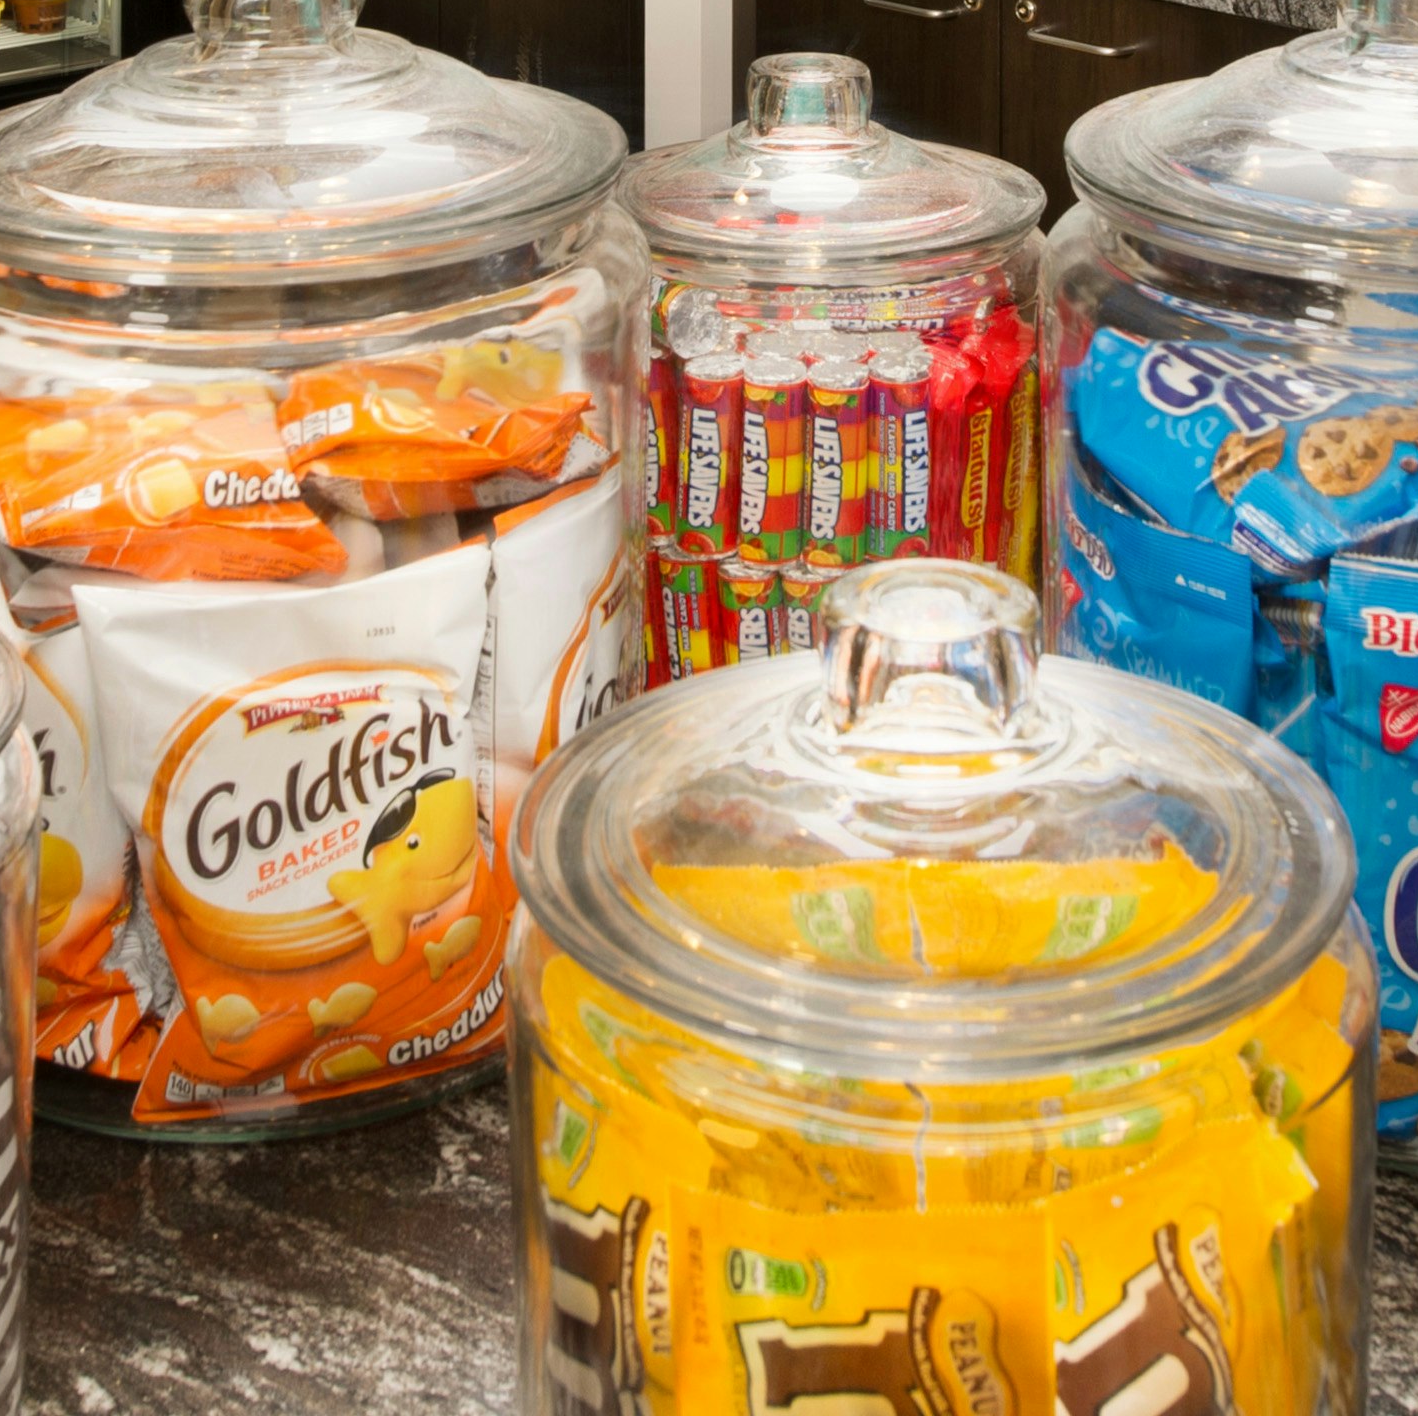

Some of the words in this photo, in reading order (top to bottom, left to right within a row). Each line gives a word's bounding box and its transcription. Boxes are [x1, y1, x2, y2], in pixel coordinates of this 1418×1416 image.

[186, 697, 456, 880] Goldfish
[246, 872, 290, 903] SNACK
[292, 839, 360, 882] CRACKERS
[257, 819, 362, 882] BAKED
[949, 1321, 1005, 1416] PEANU
